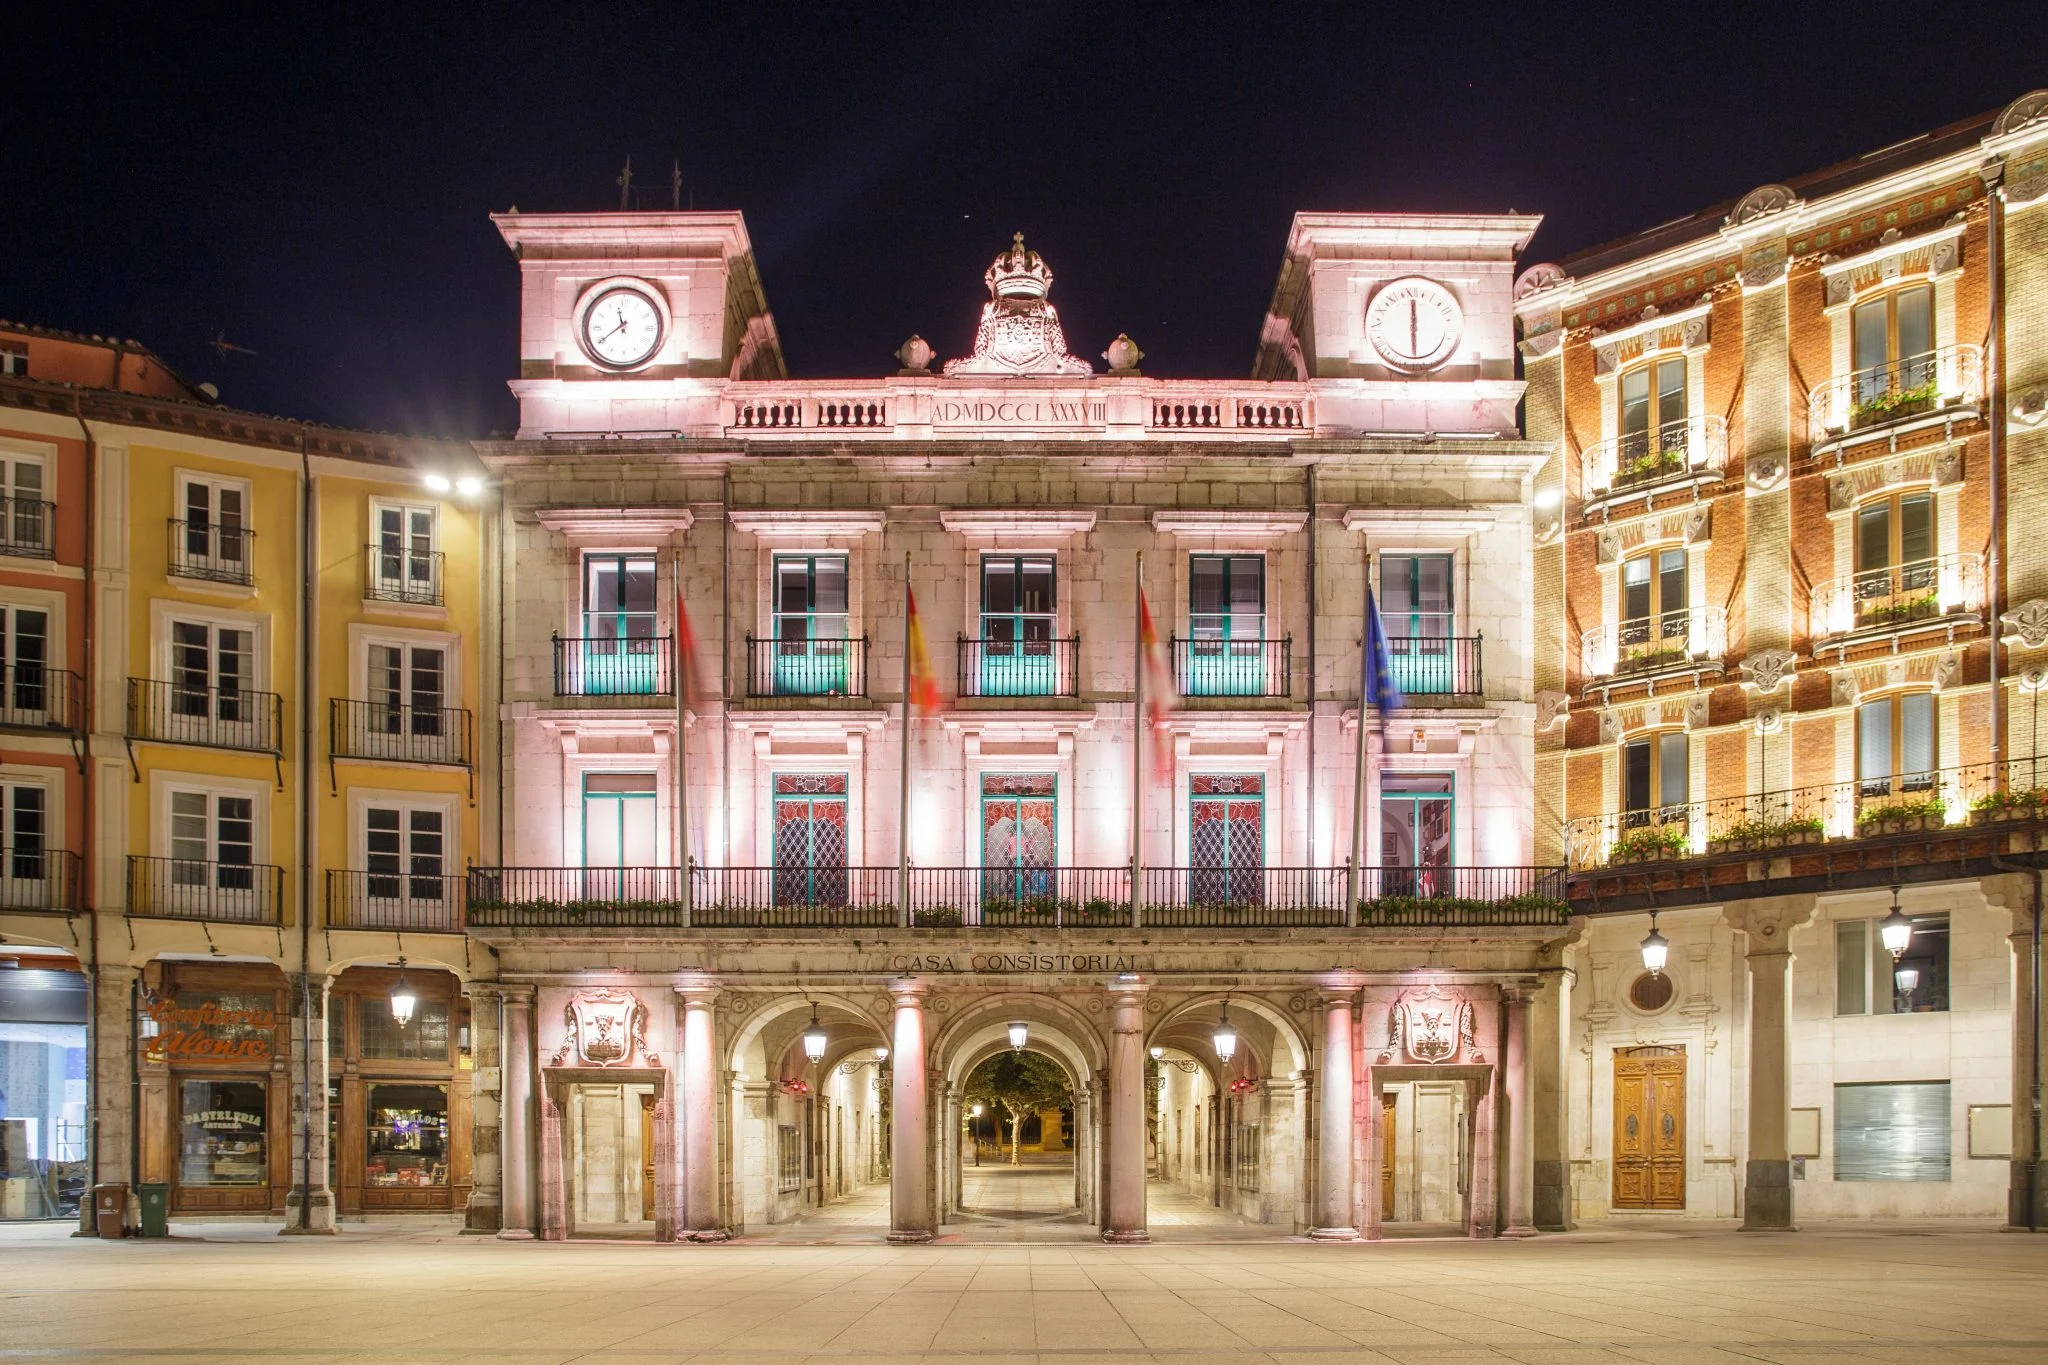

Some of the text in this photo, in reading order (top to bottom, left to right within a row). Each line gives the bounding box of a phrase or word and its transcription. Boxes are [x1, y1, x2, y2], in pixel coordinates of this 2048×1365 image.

[893, 955, 1143, 970] CASA CONSISTORIAL
[144, 1030, 271, 1063] Alonso
[183, 1110, 261, 1126] PASTELERIA
